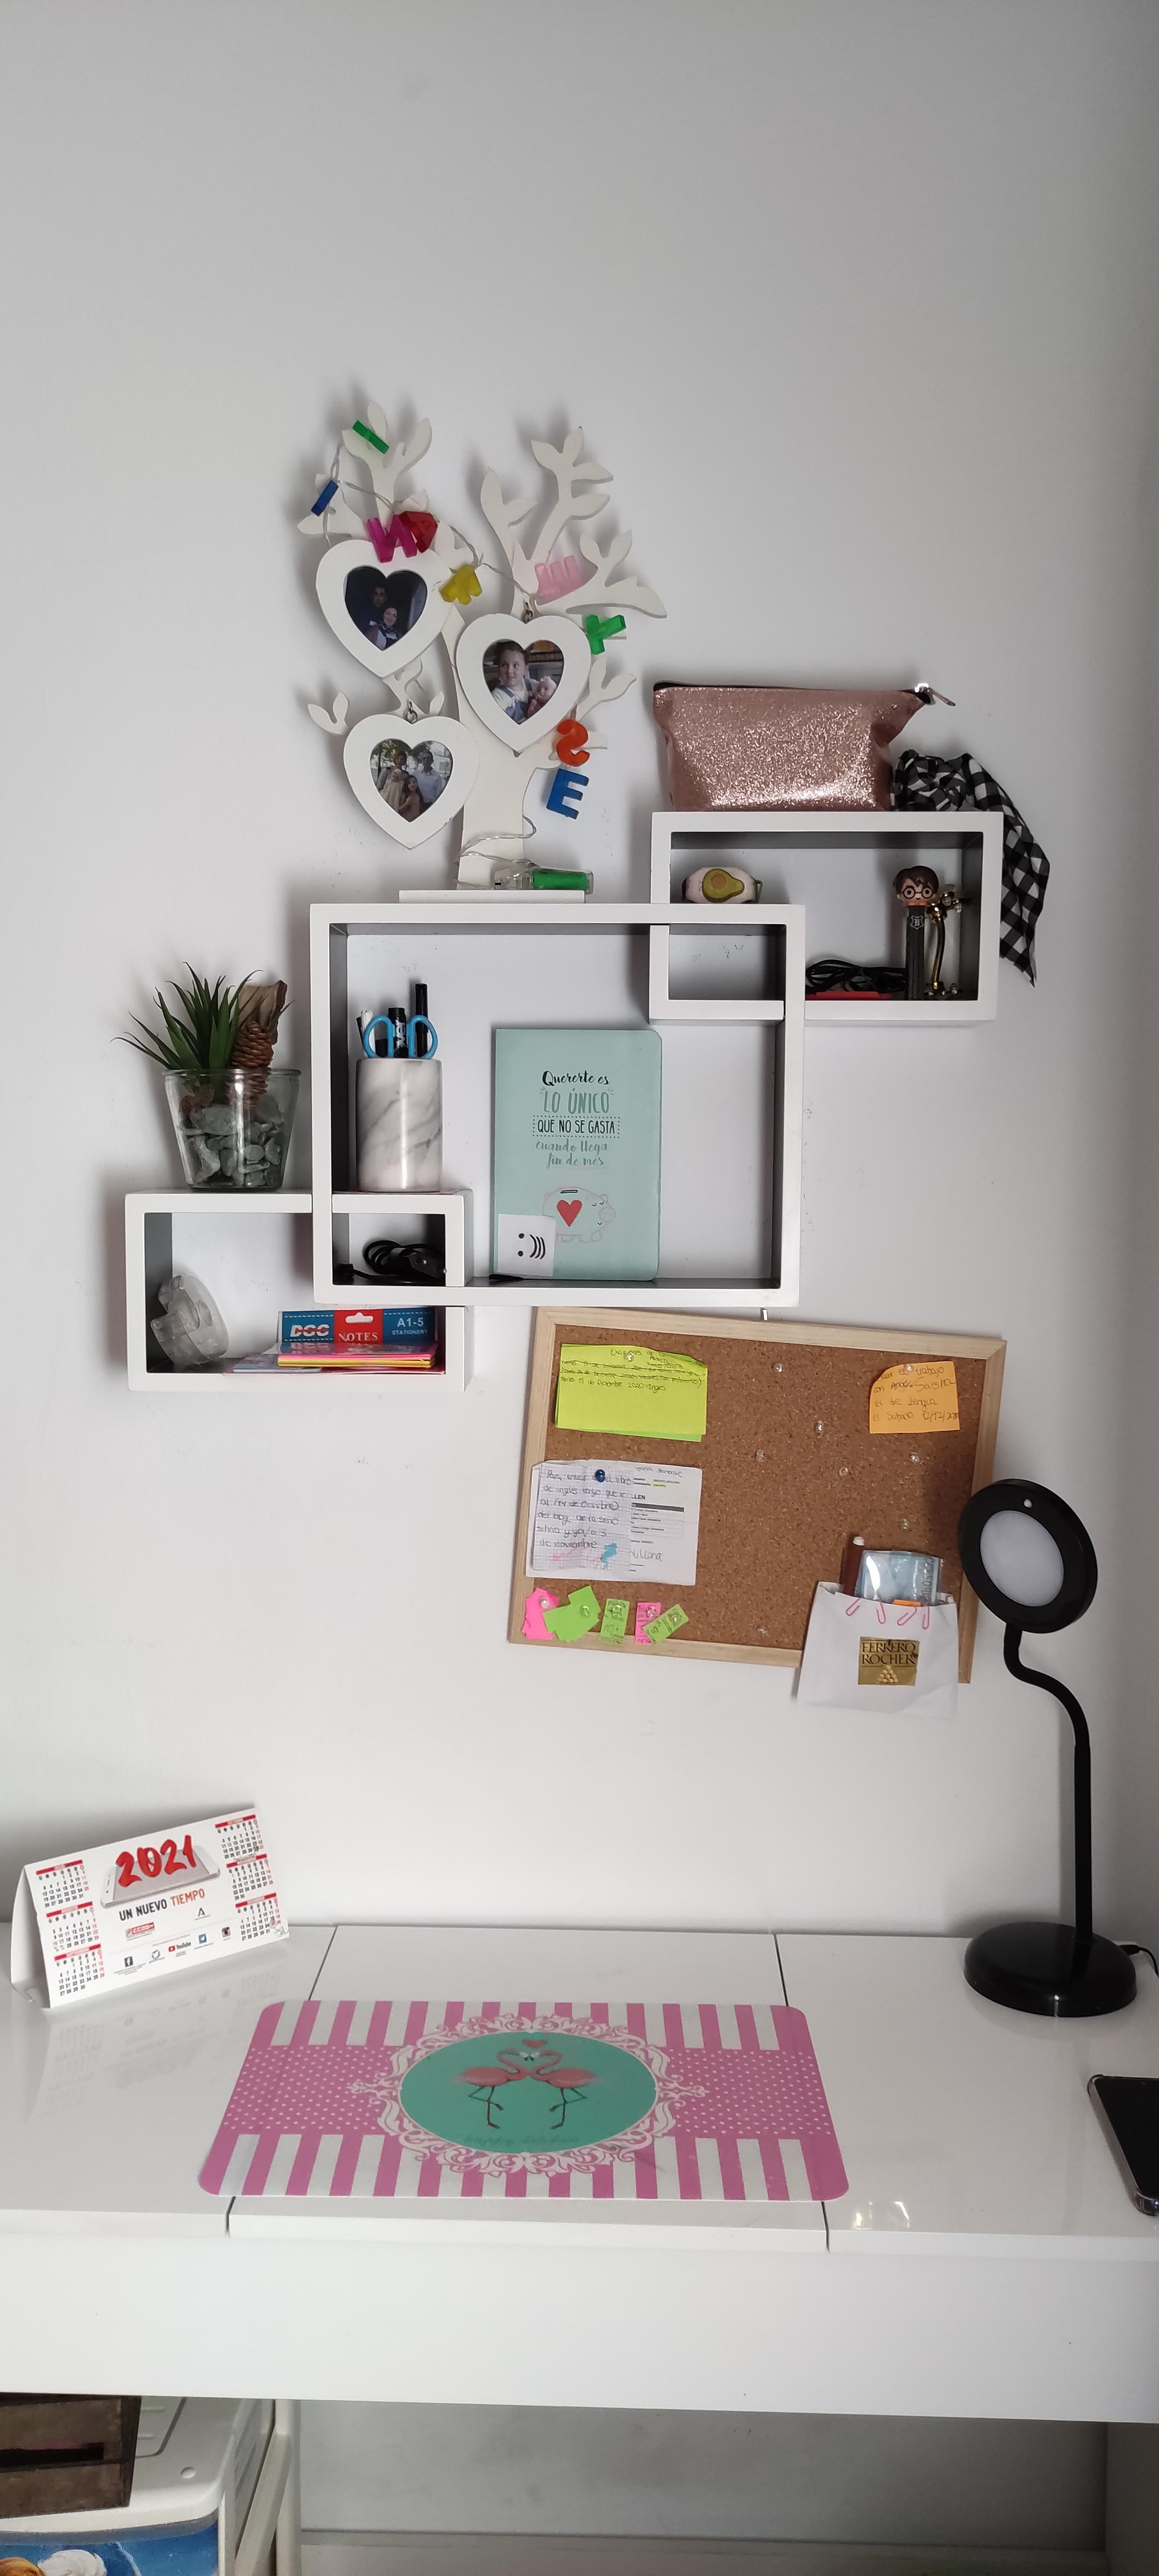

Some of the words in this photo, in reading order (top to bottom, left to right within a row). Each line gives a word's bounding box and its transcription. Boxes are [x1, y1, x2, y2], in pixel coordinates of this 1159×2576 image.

[542, 1070, 595, 1086] Quererte
[597, 1076, 610, 1085] es
[543, 1090, 561, 1113] LO
[568, 1087, 609, 1114] ÚNICO
[538, 1119, 555, 1133] QUE
[559, 1119, 572, 1133] NO
[574, 1120, 585, 1133] SE
[588, 1120, 615, 1134] GASTA
[535, 1138, 576, 1152] cuando
[581, 1140, 607, 1155] llega
[546, 1153, 562, 1169] fin
[566, 1153, 579, 1166] de
[583, 1157, 604, 1166] mes
[397, 1318, 424, 1327] A1-5
[338, 1332, 378, 1343] NOTES
[915, 1365, 944, 1378] trabajo
[862, 1642, 916, 1653] FERRERO
[862, 1653, 916, 1665] ROCHER
[116, 1835, 197, 1887] 2021
[119, 1909, 133, 1921] UN
[135, 1899, 168, 1917] NUEVO
[170, 1888, 205, 1906] TIEMPO
